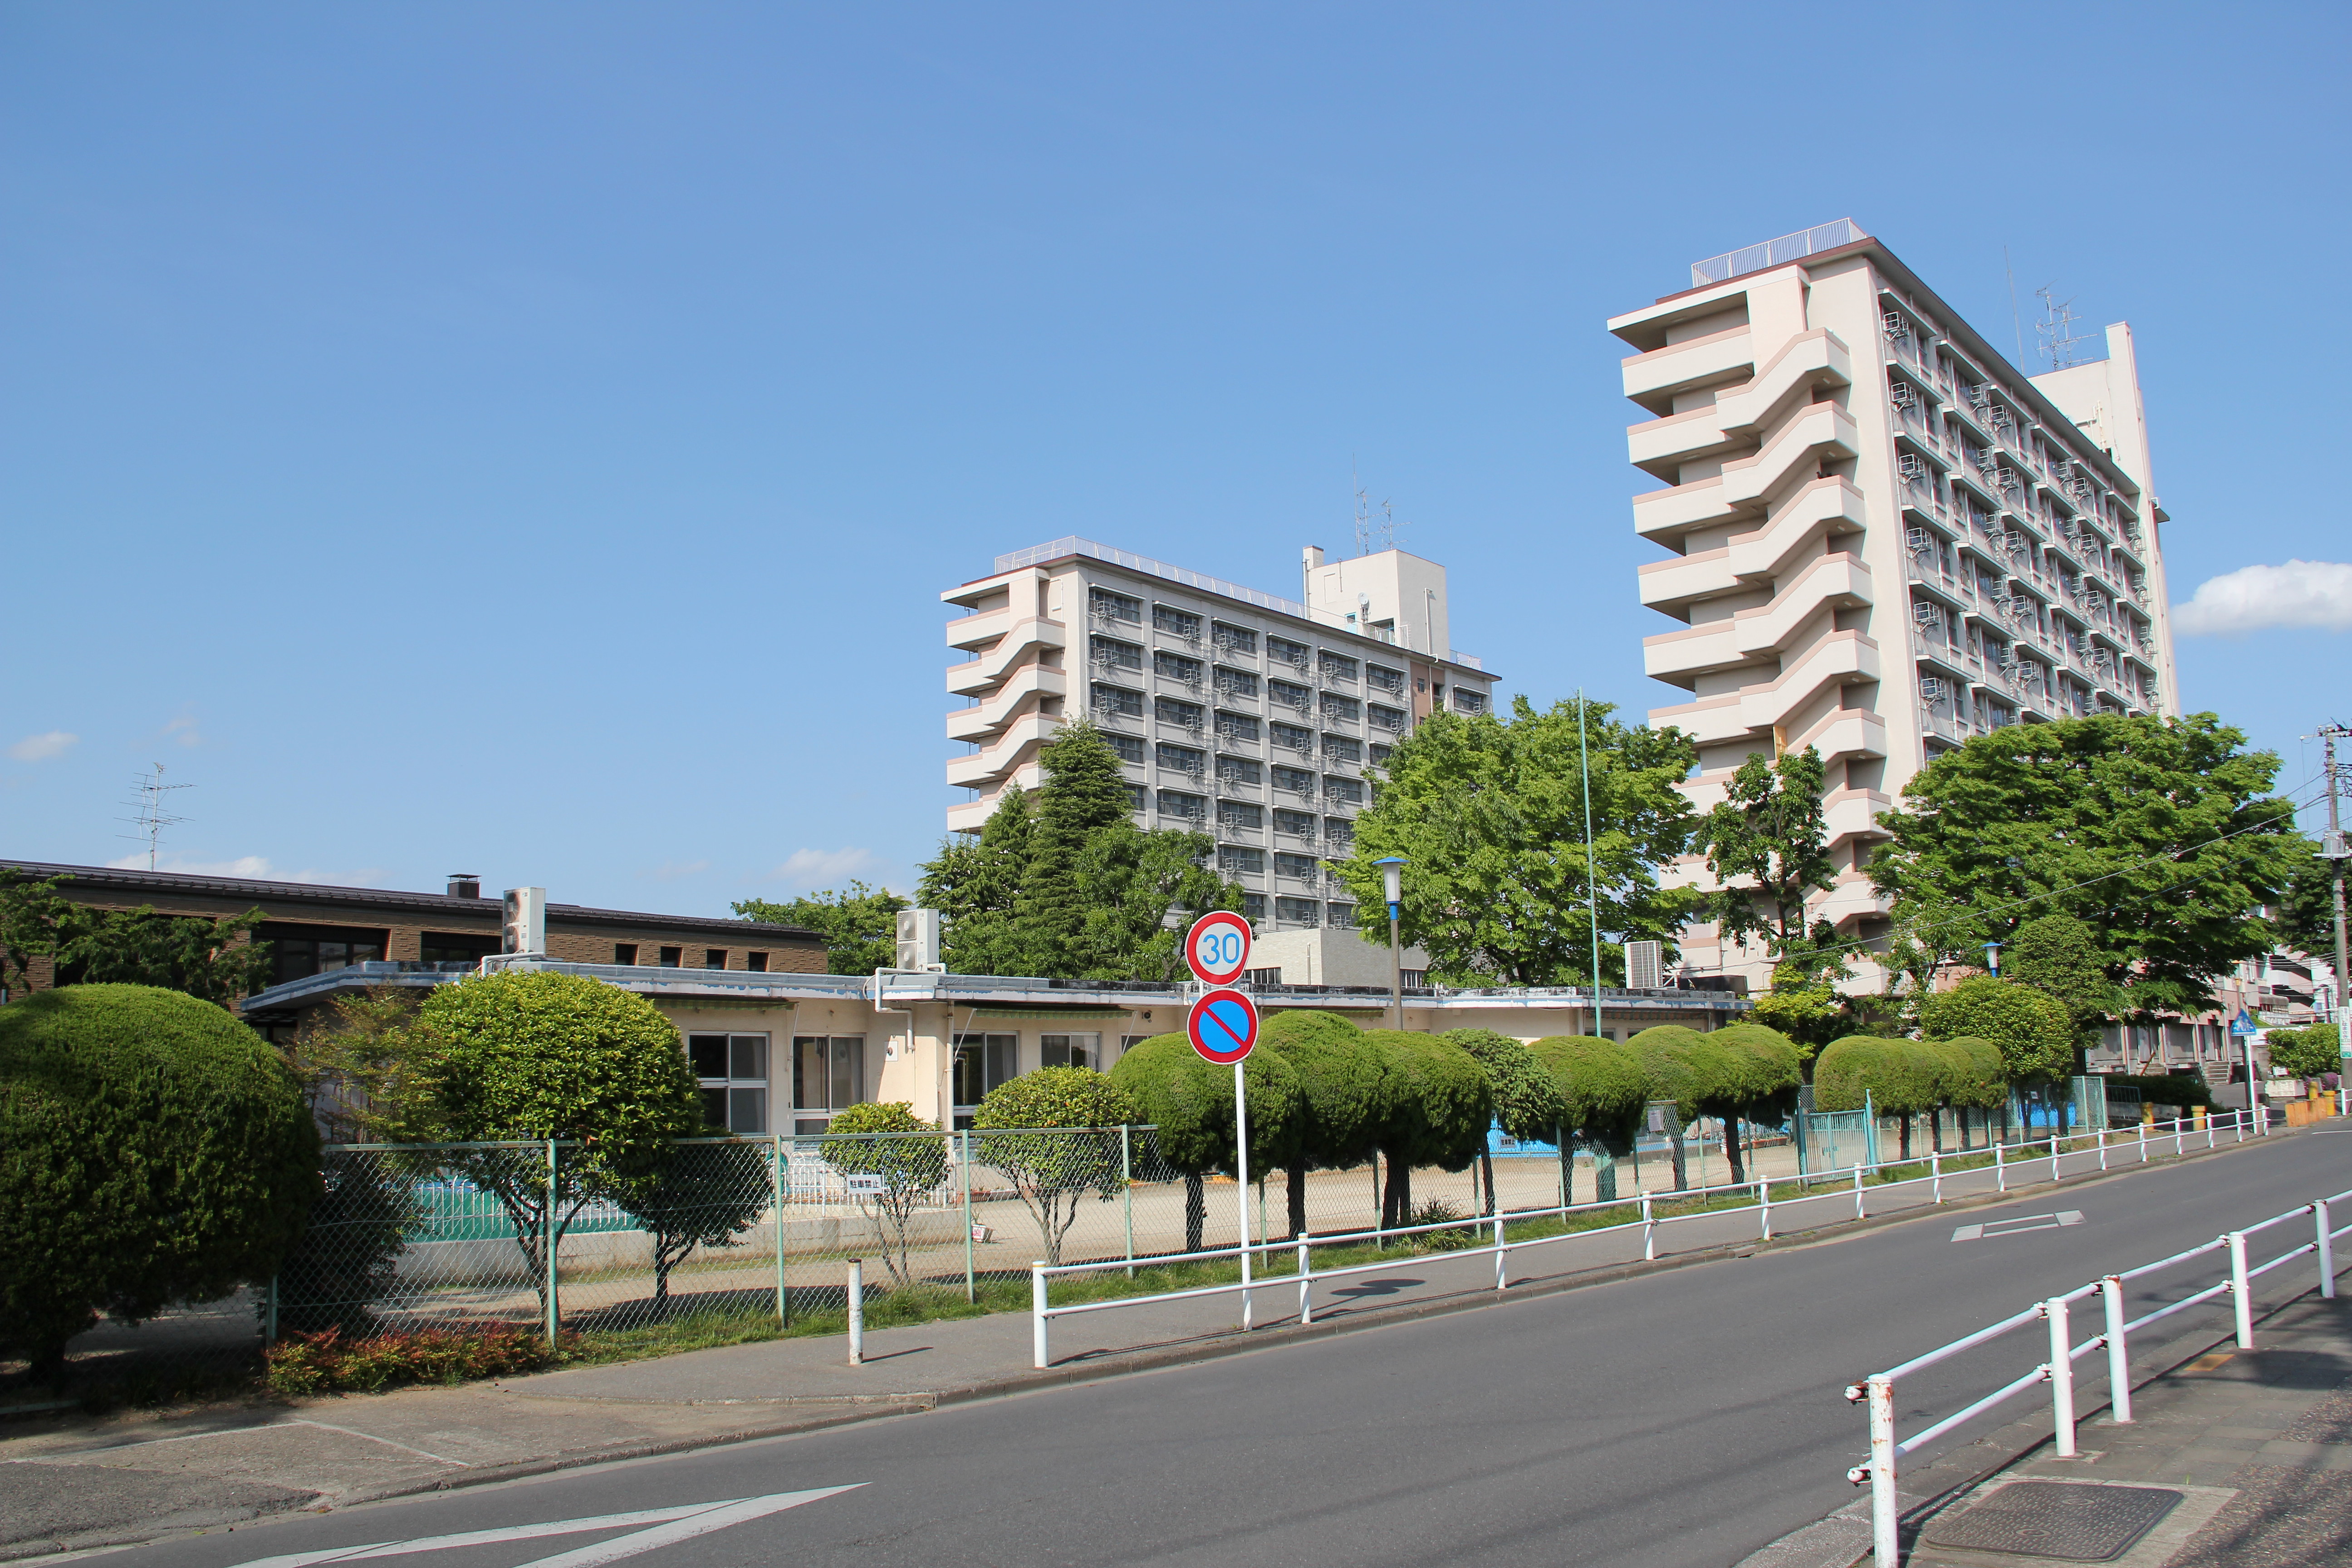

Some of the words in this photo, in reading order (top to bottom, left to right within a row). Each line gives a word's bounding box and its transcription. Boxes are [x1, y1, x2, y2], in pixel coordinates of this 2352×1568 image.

[1203, 933, 1240, 965] 30
[850, 1180, 879, 1188] 駐車禁止
